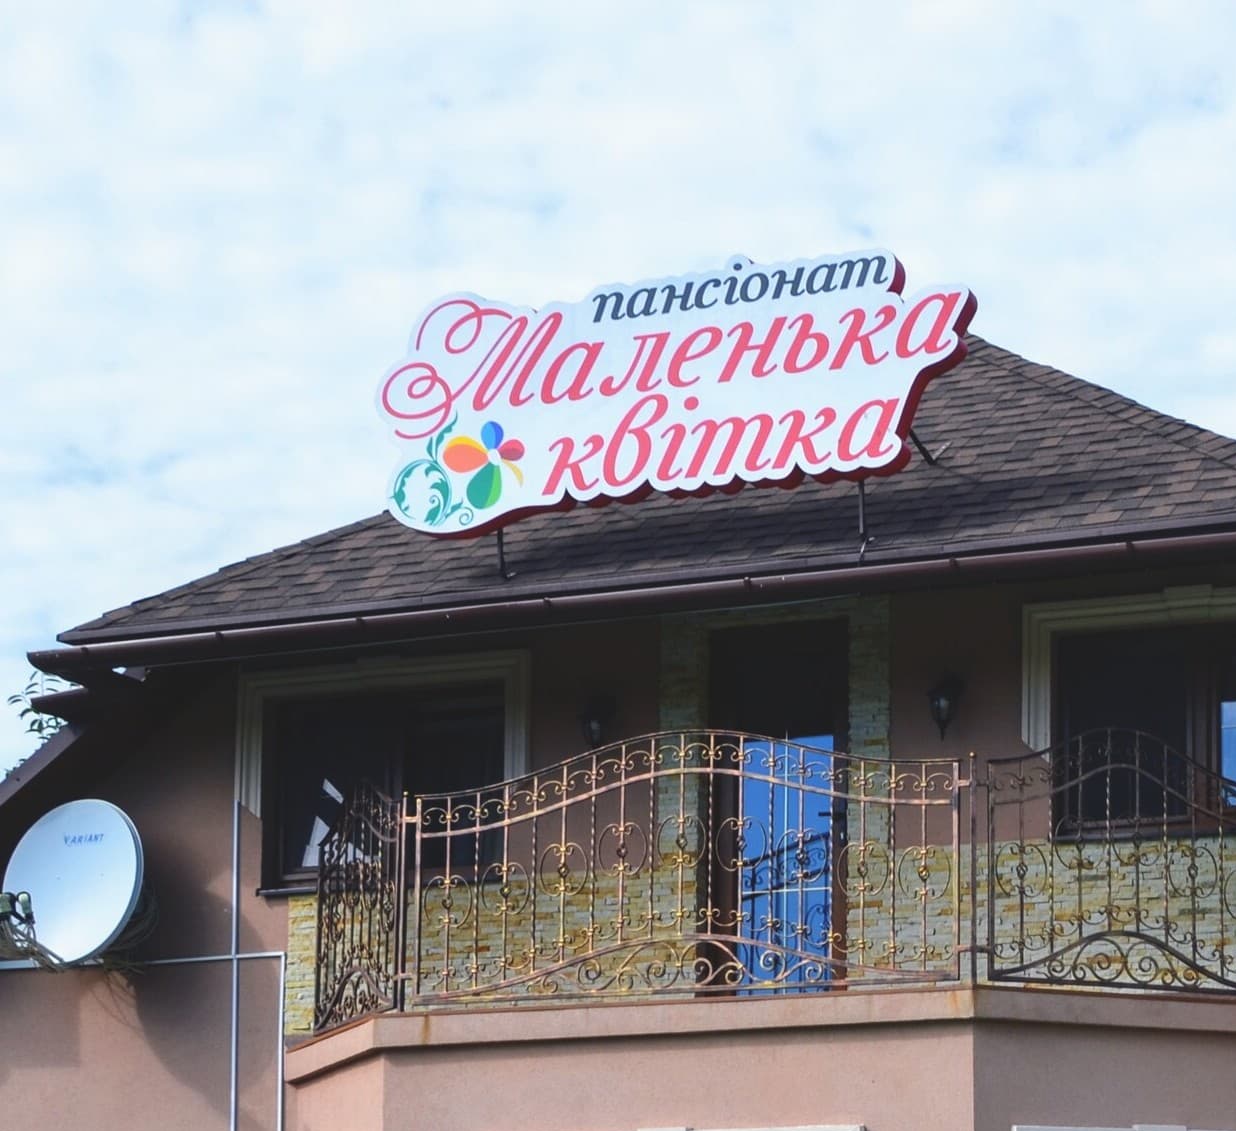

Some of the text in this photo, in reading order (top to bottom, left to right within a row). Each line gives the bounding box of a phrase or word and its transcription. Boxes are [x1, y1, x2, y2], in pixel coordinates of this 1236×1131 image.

[593, 255, 889, 324] пансіонат
[381, 290, 963, 440] Маленька
[541, 393, 901, 497] квітка
